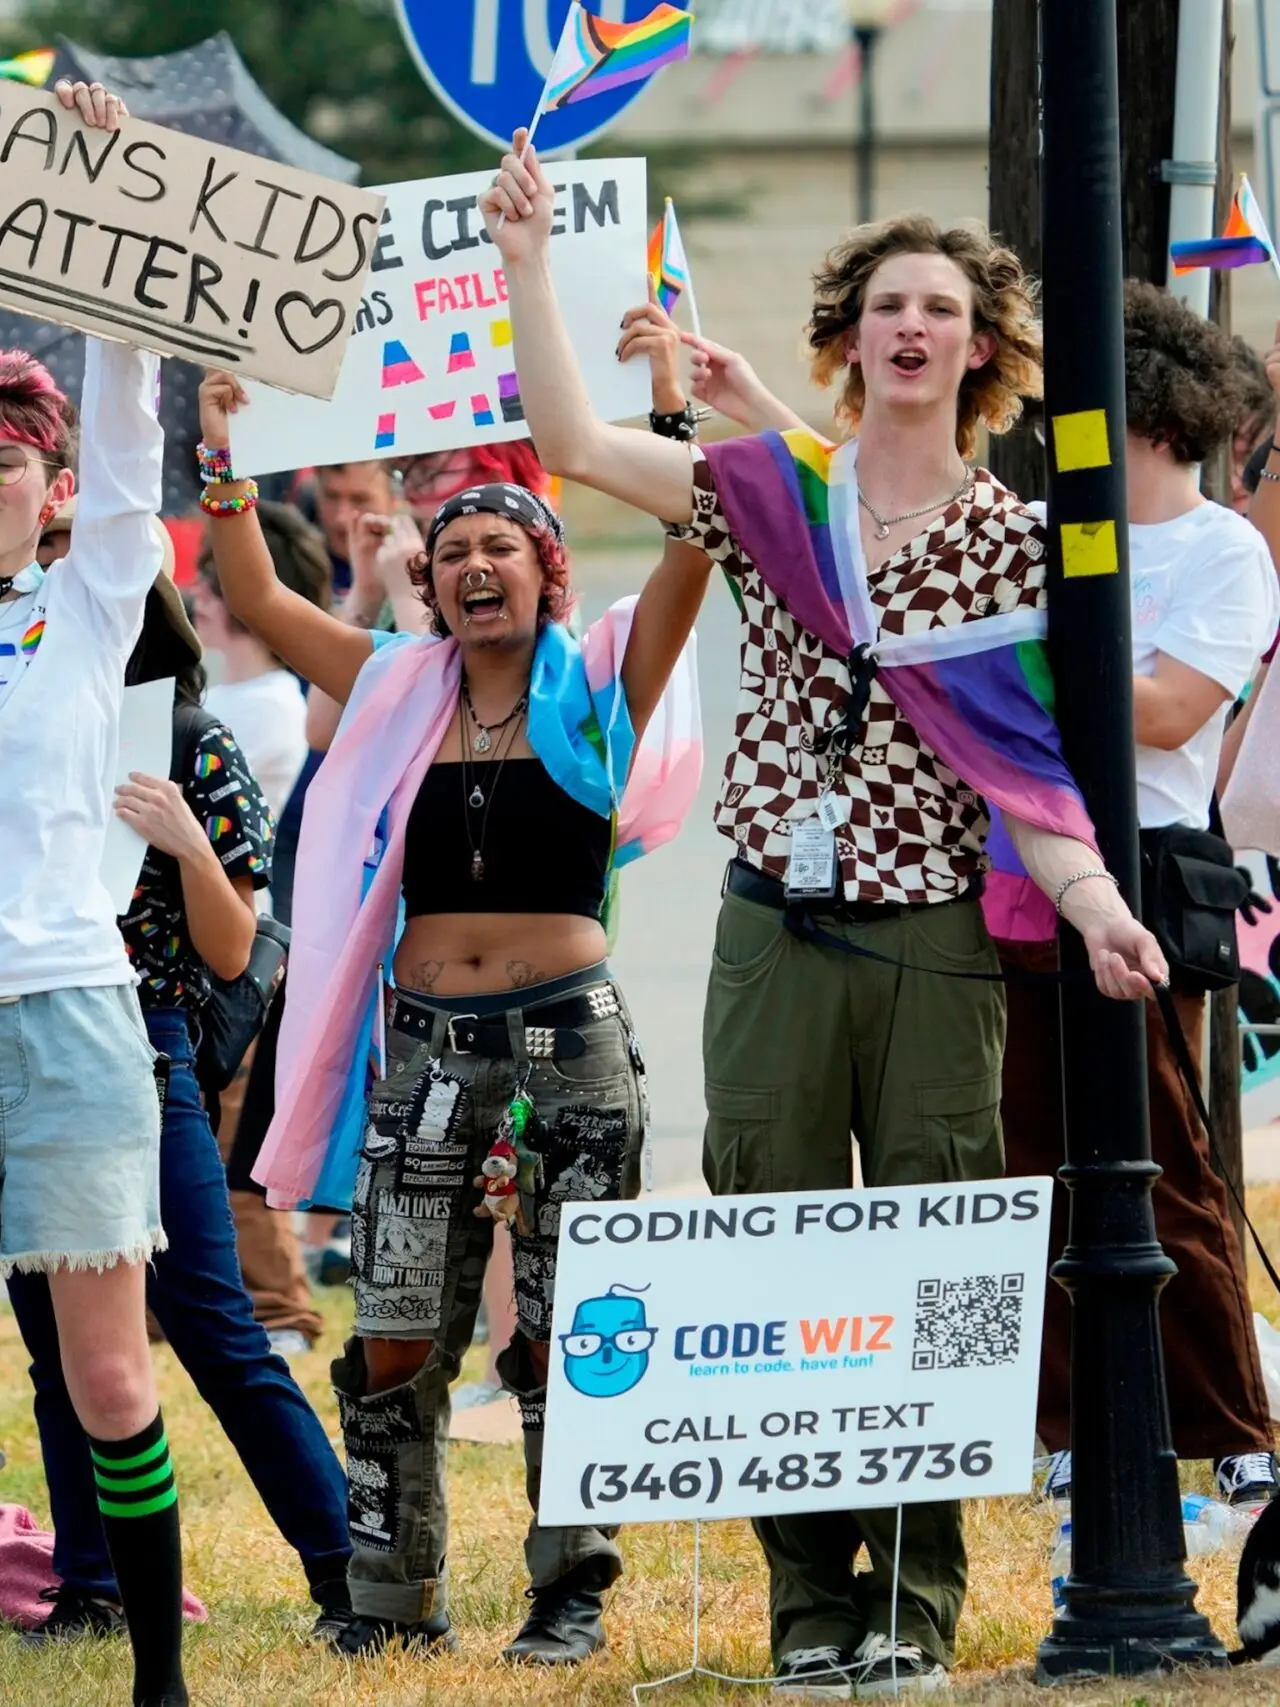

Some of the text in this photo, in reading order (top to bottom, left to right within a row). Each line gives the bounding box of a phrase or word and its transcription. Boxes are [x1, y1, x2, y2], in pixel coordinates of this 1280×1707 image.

[190, 156, 377, 282] KIDS
[422, 179, 620, 260] CIEM
[378, 1193, 452, 1219] NAZI LIVES
[568, 1189, 1040, 1245] CODING FOR KIDS
[373, 1264, 404, 1285] DON'T
[674, 1314, 895, 1361] CODE WIZ
[689, 1362, 730, 1377] learn
[734, 1361, 749, 1375] to
[800, 1356, 838, 1371] have
[842, 1353, 874, 1369] fun!
[644, 1402, 934, 1445] CALL OR TEXT
[579, 1440, 994, 1510] (346) 483 3736
